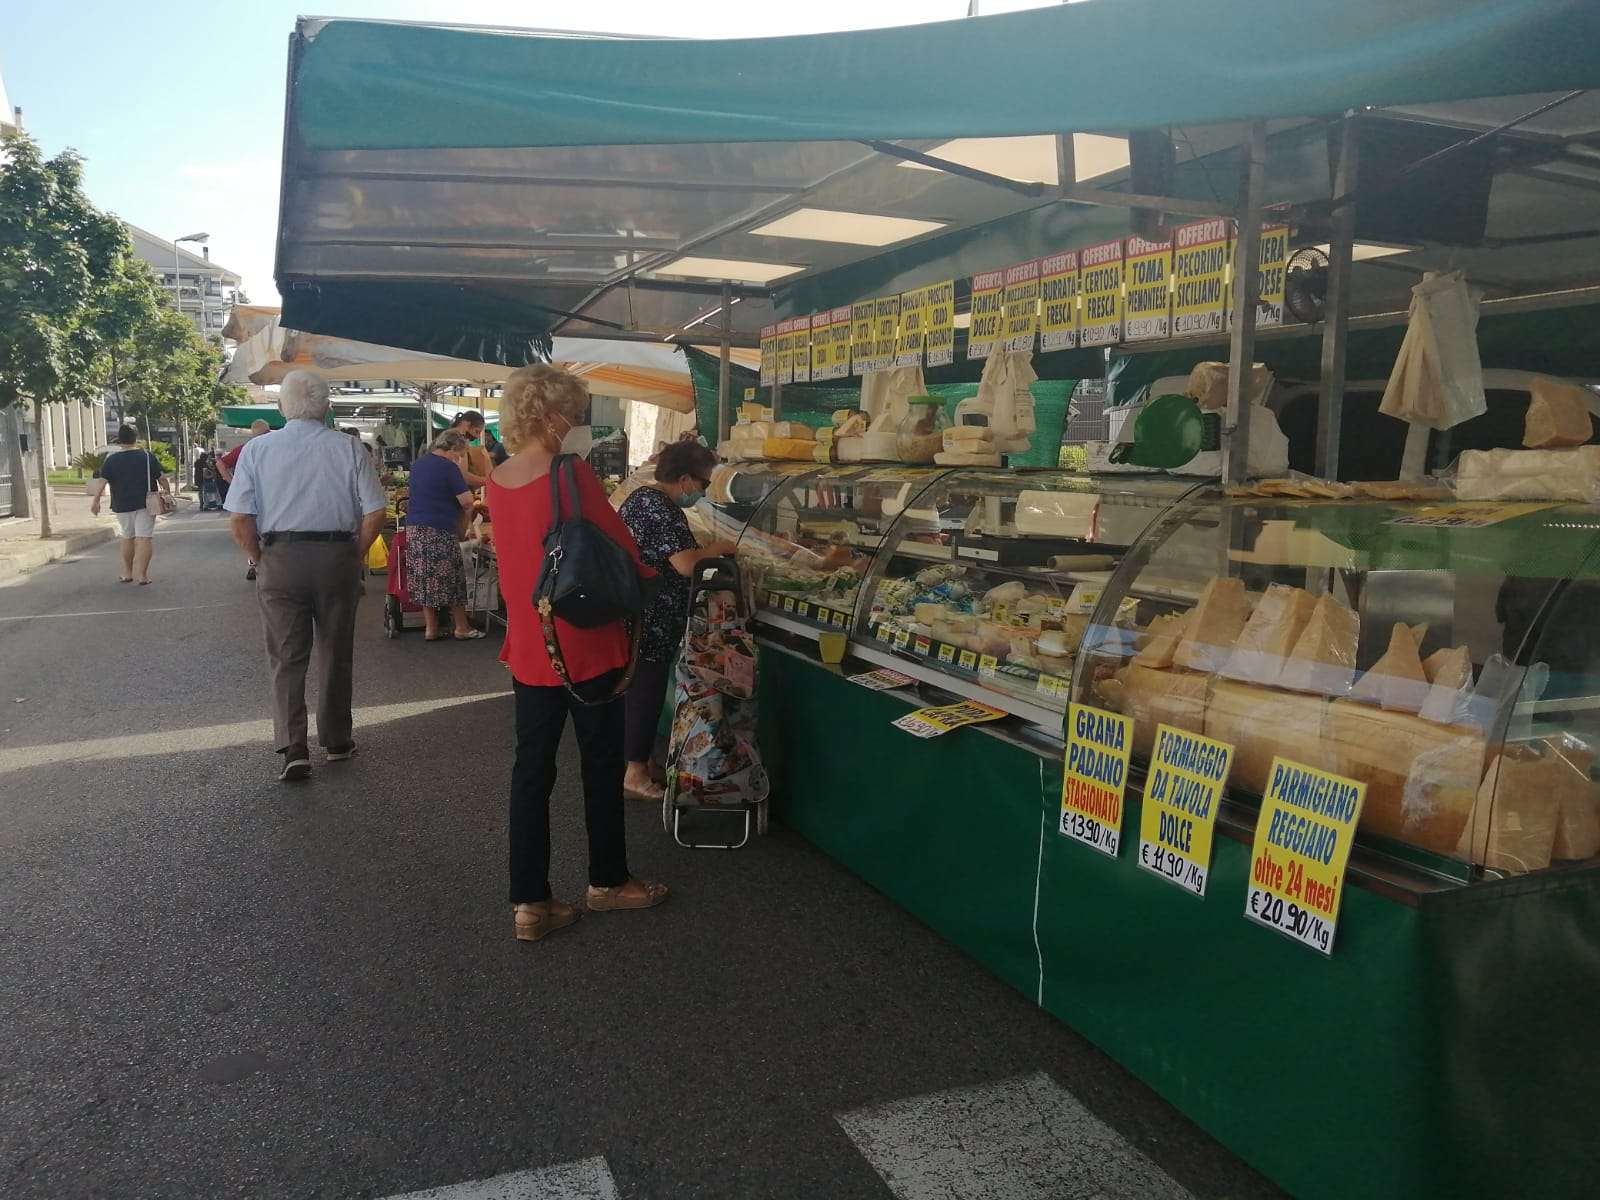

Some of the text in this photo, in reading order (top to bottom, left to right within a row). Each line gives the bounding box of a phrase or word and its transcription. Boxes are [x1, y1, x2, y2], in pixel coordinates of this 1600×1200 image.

[1179, 219, 1225, 247] OFFERTA
[1043, 253, 1077, 275] OFFERTA
[1083, 241, 1121, 265] OFFERTA
[1178, 246, 1224, 279] PECORINO
[974, 272, 1003, 290] OFFERTA
[1007, 262, 1038, 285] OFFERTA
[1085, 267, 1119, 294] CERTOSA
[1133, 258, 1164, 286] TOMA
[1043, 276, 1076, 302] BURRATA
[1128, 285, 1167, 313] PIEMONTESE
[1177, 278, 1222, 308] SICILIANO
[1047, 302, 1072, 327] FRESCA
[1087, 294, 1115, 320] FRESCA
[973, 316, 998, 337] DOLCE
[1076, 709, 1124, 752] GRANA
[1069, 742, 1124, 788] PADANO
[1157, 730, 1228, 781] FORMAGGIO
[1065, 776, 1120, 825] STAGIONATO
[1151, 768, 1213, 820] DA TAVOLA
[1270, 763, 1359, 824] PARMIGIANO
[1159, 810, 1193, 854] DOLCE
[1267, 807, 1338, 866] REGGIANO
[1254, 847, 1338, 914] oltre 24 mesi
